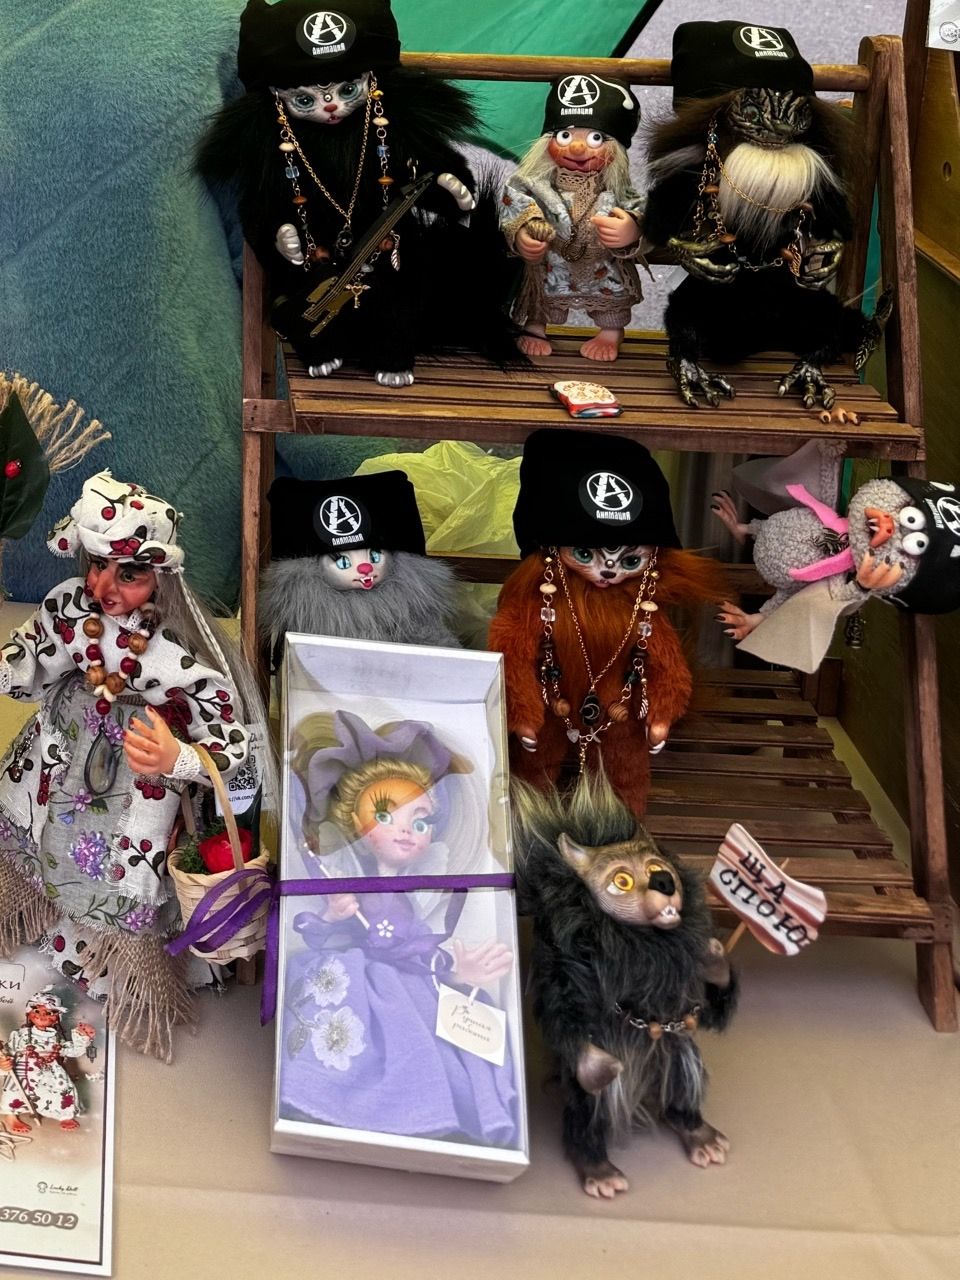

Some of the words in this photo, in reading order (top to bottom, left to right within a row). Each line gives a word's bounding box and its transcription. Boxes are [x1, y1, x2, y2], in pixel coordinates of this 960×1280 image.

[719, 868, 809, 944] СПОЮ
[0, 1208, 29, 1222] 376
[32, 1212, 52, 1224] 50
[56, 1214, 75, 1227] 12
